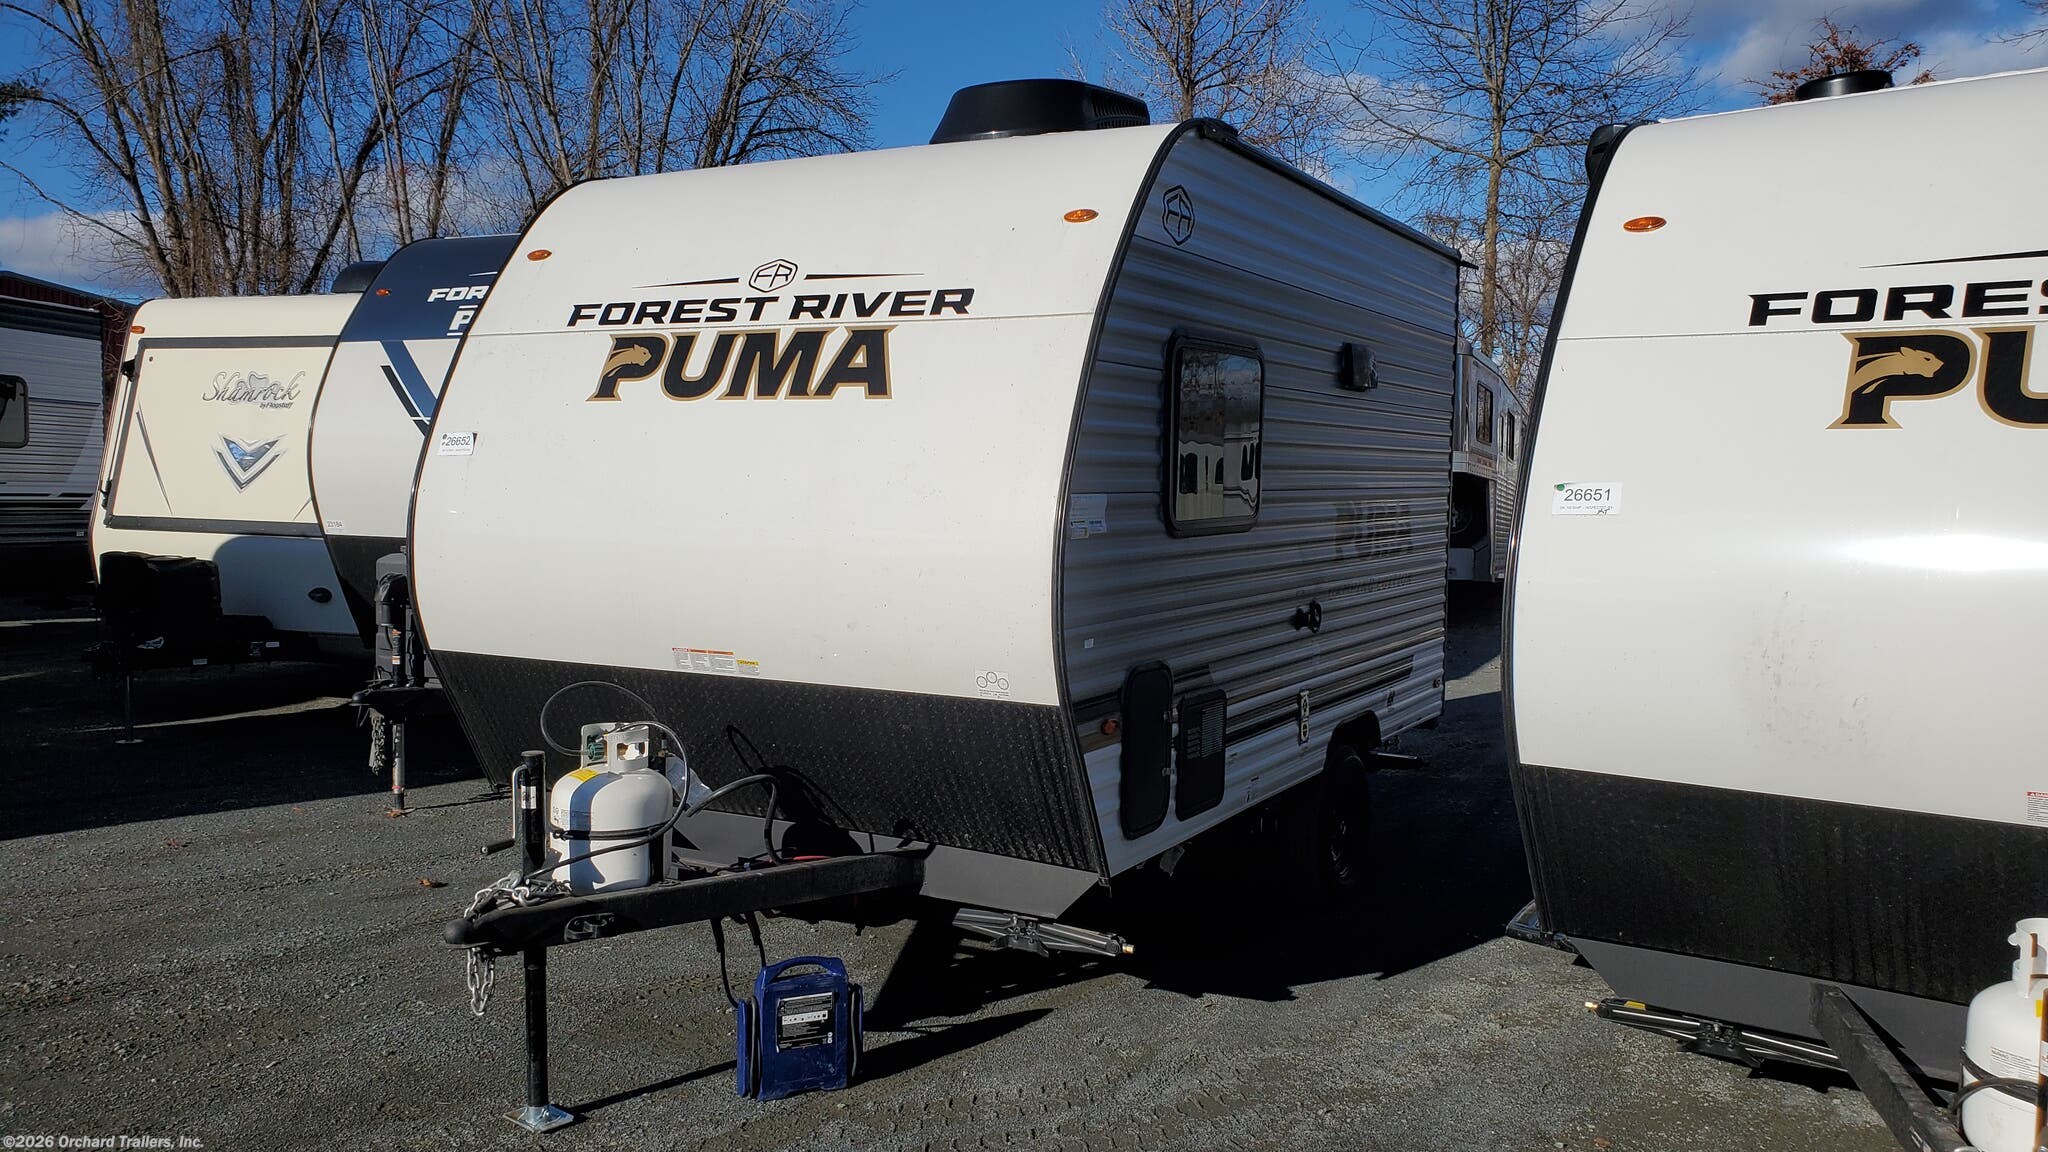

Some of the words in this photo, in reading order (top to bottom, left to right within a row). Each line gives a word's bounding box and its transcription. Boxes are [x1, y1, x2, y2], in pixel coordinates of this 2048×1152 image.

[566, 296, 780, 327] FOREST
[788, 288, 976, 320] RIVER
[1748, 279, 2048, 327] FORE
[585, 324, 899, 402] PUMA
[202, 370, 306, 402] Shamrock
[445, 436, 471, 447] 26652
[1563, 488, 1611, 502] 26651
